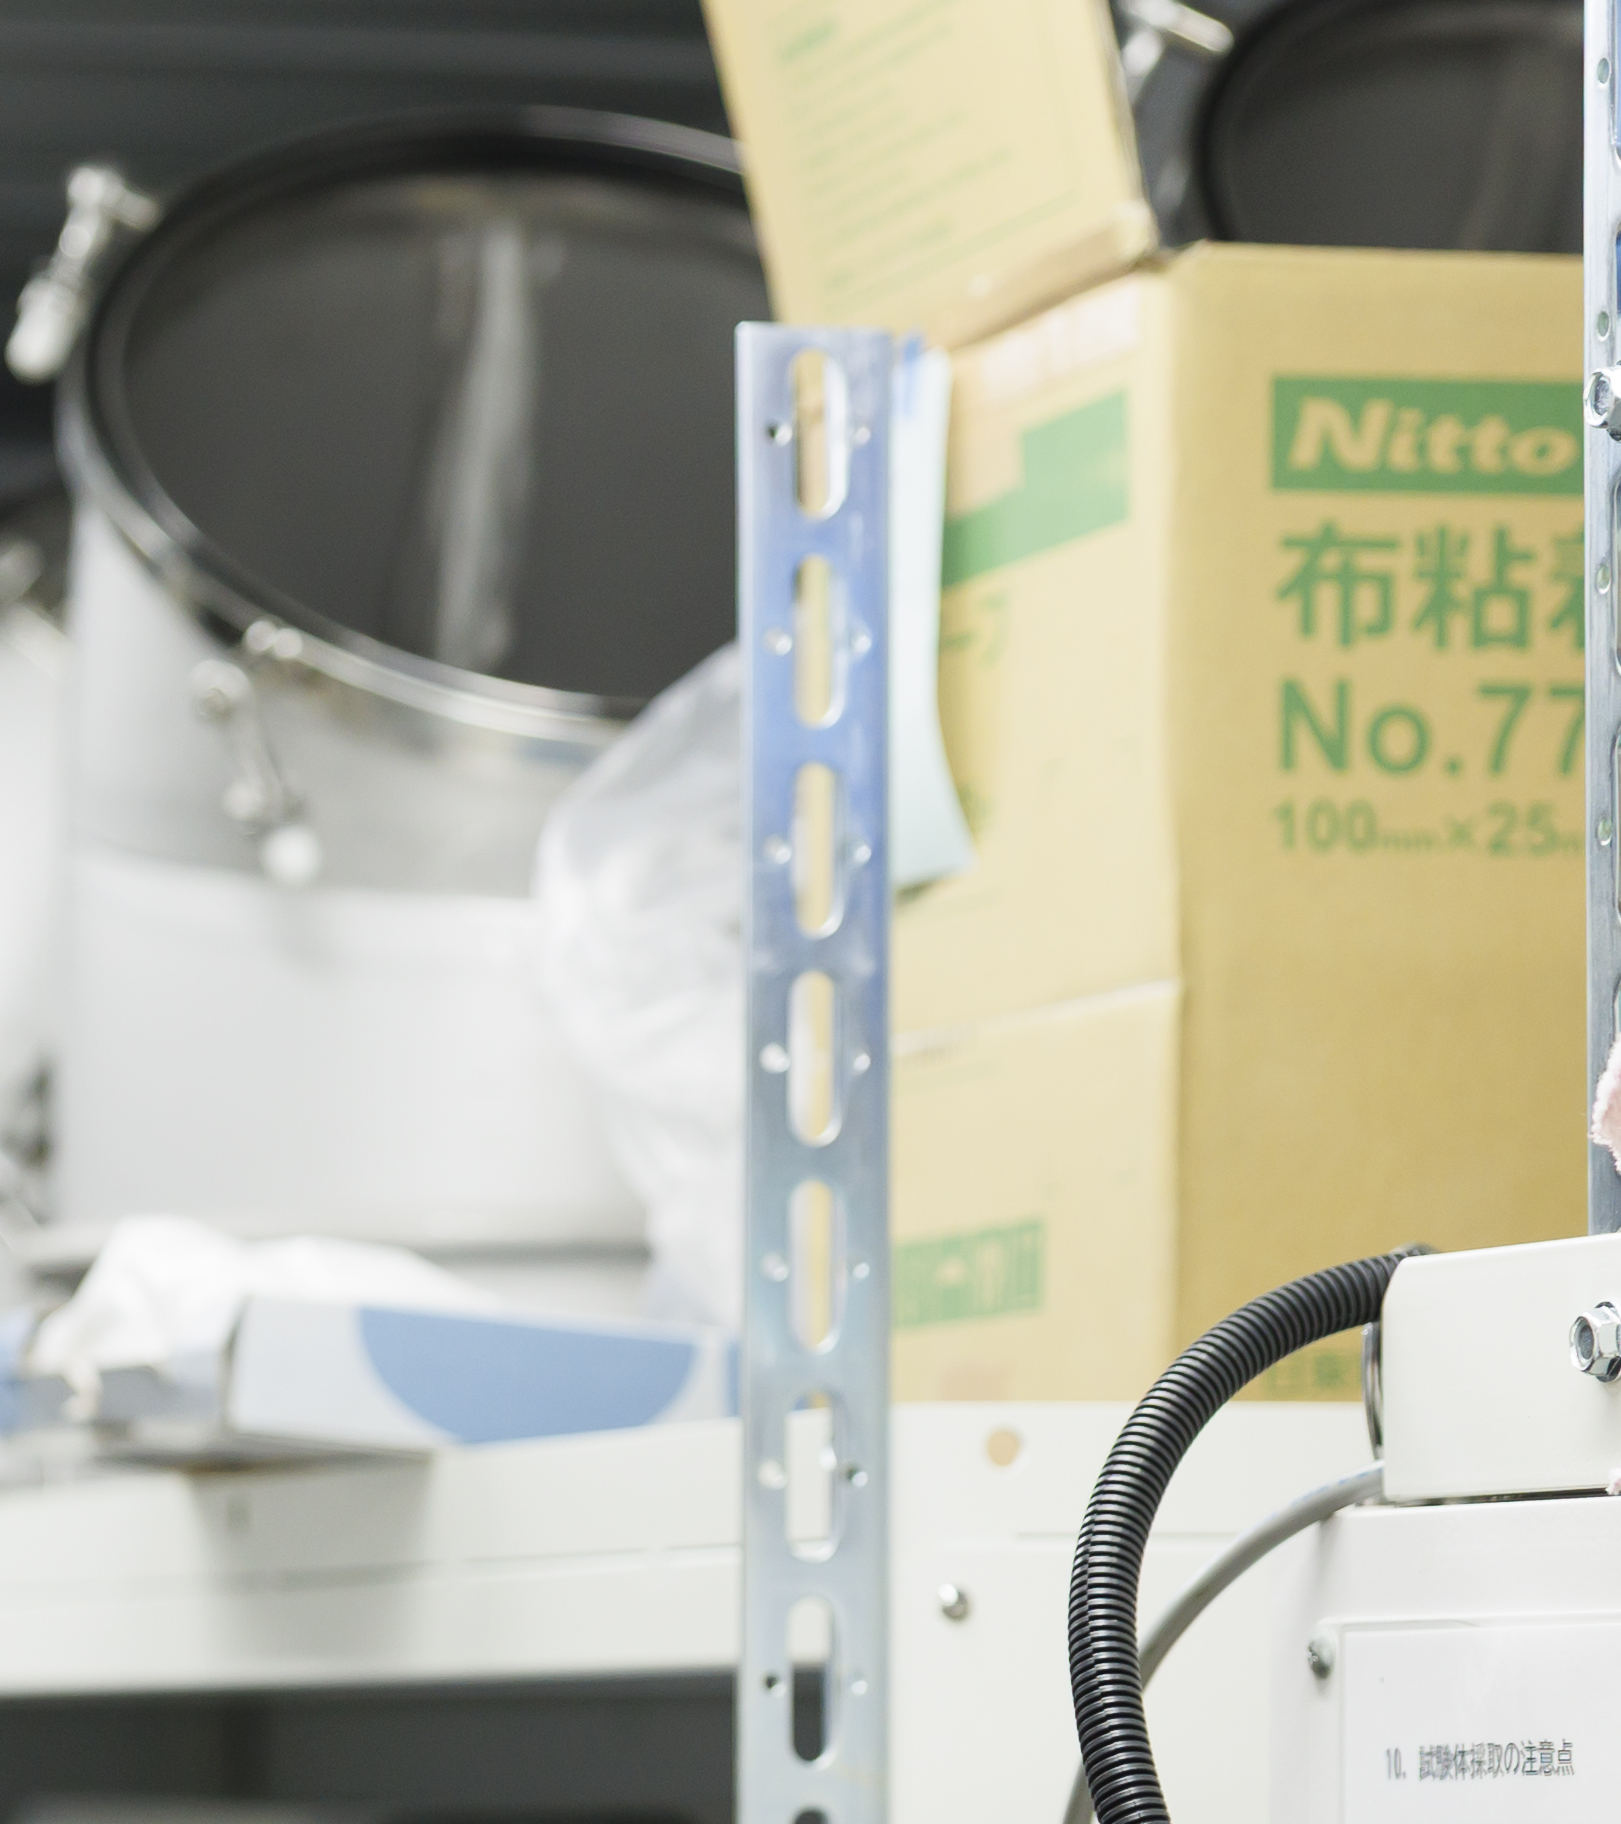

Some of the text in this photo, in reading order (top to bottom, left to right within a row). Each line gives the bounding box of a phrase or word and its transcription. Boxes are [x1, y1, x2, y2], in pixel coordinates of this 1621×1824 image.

[1287, 396, 1581, 477] Nitto
[1276, 520, 1585, 651] 布粘
[1419, 1739, 1575, 1781] 試験体採取の注意点
